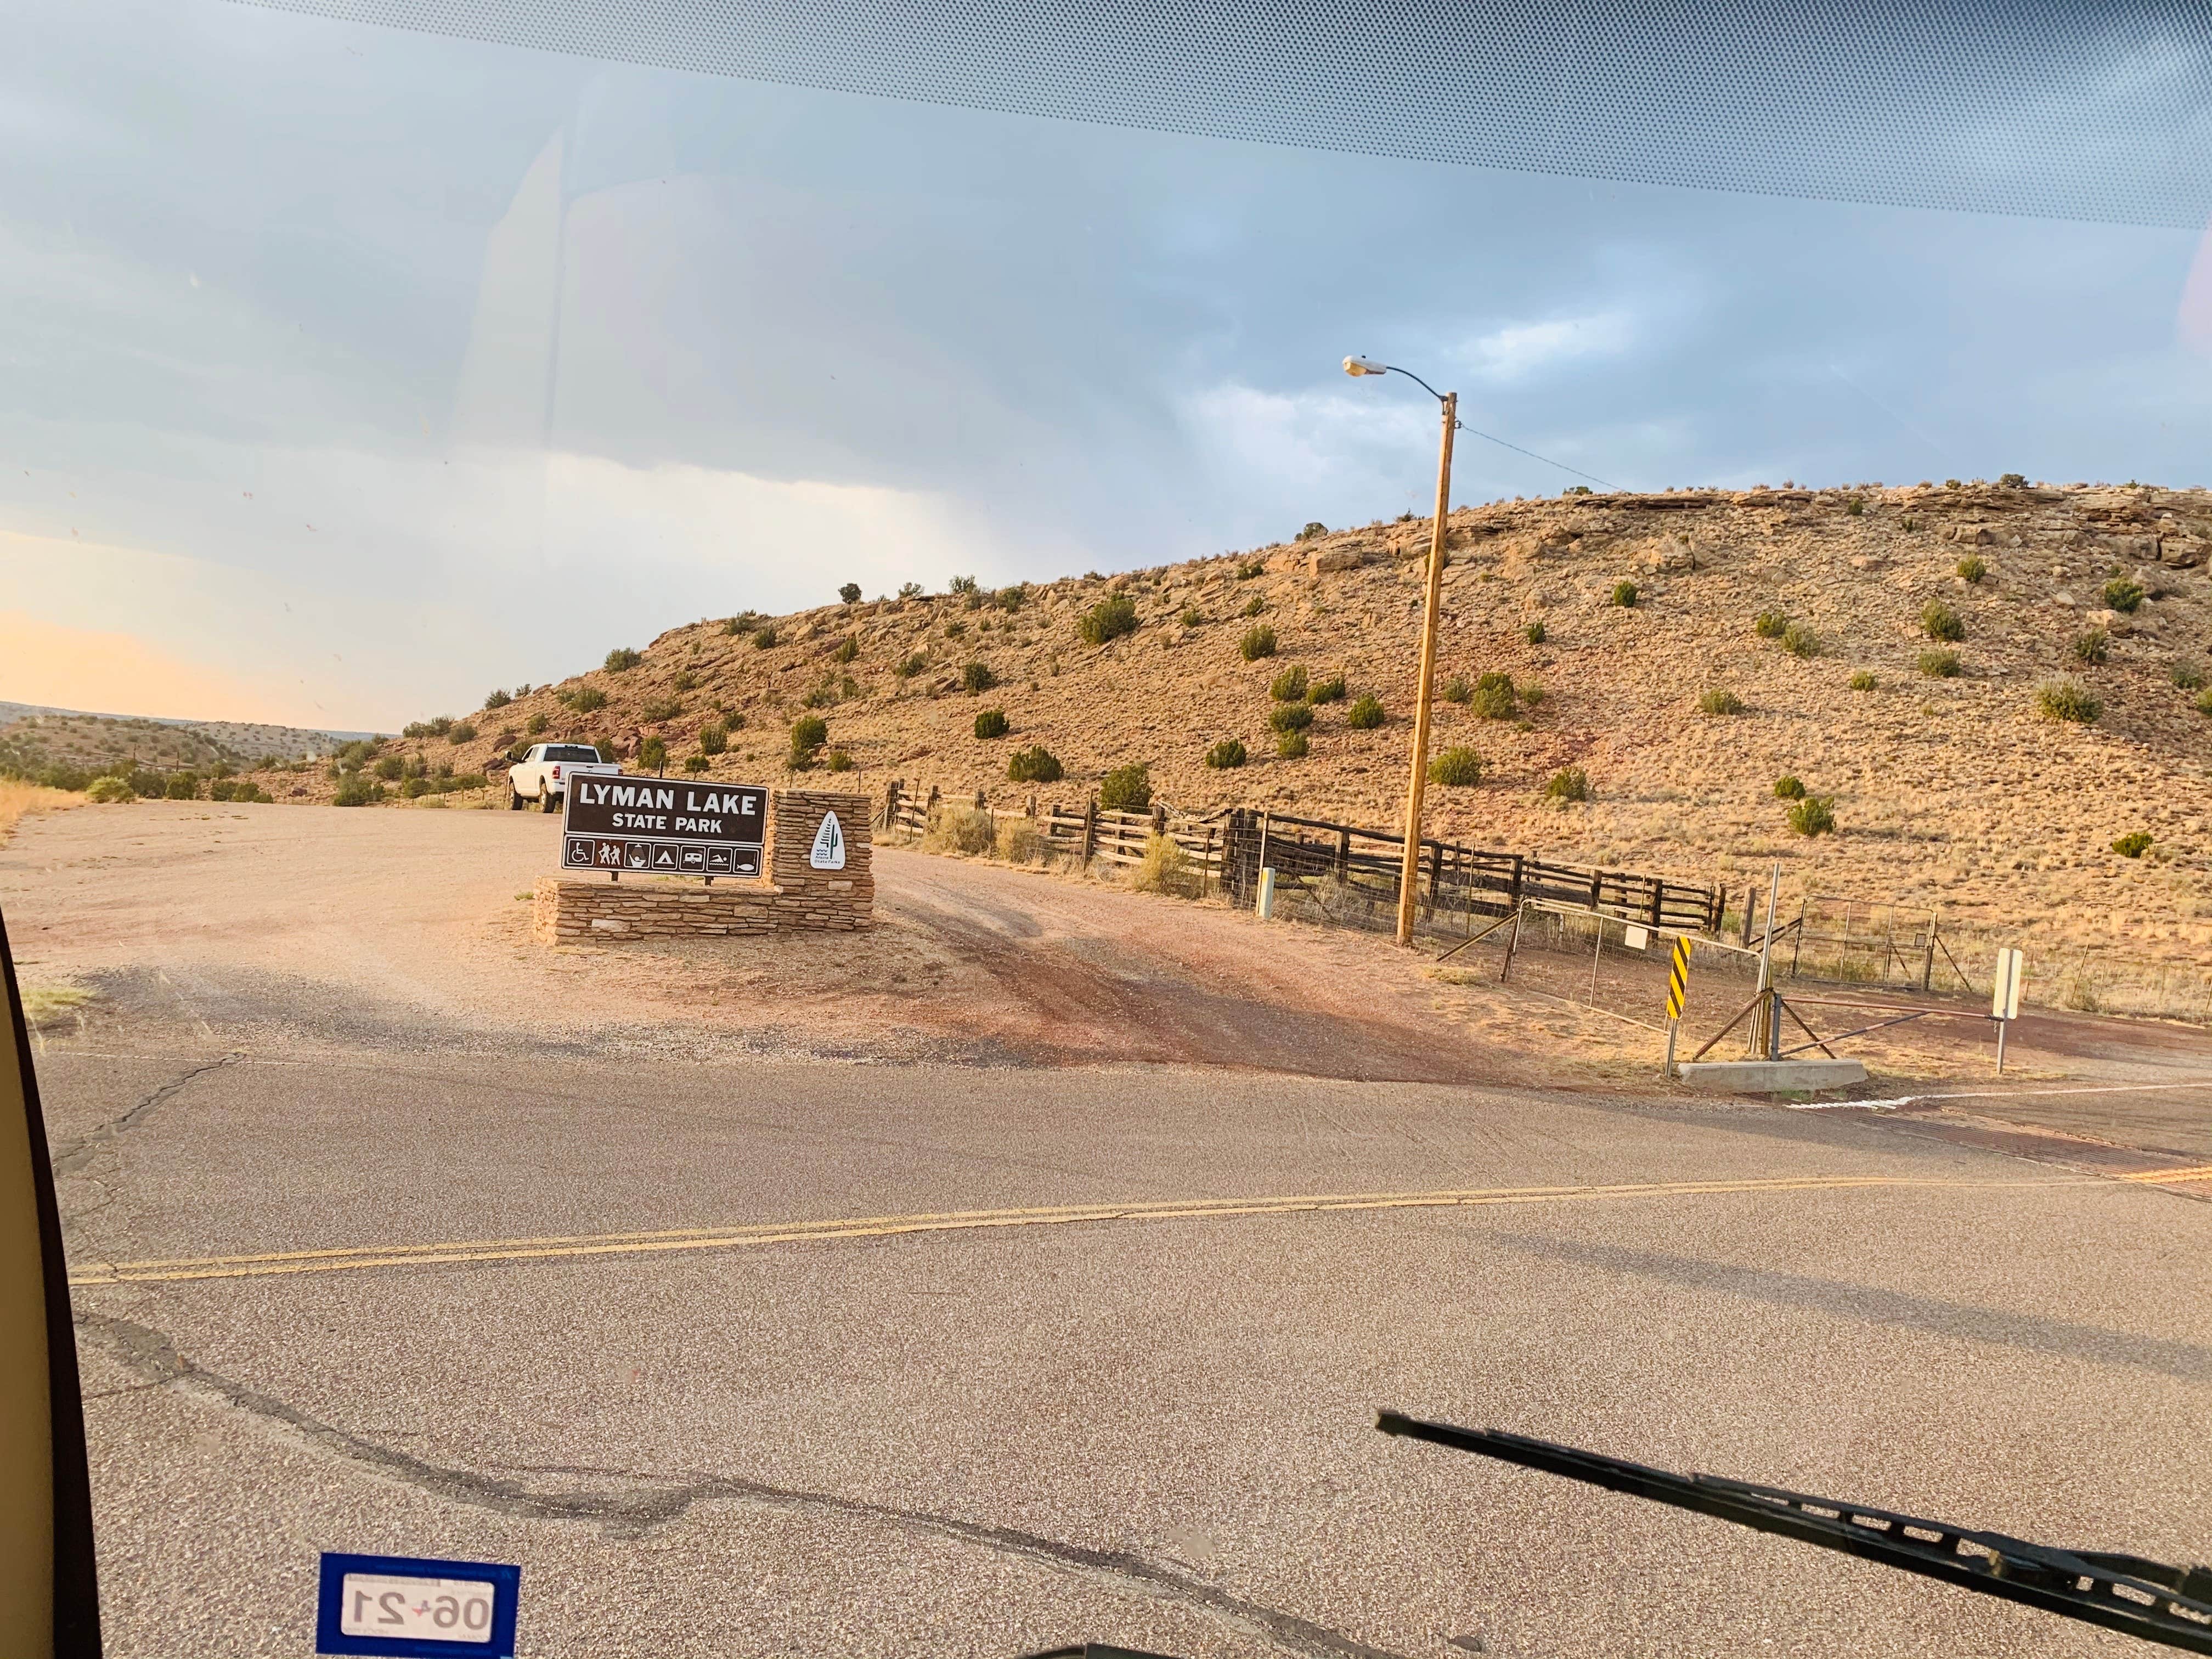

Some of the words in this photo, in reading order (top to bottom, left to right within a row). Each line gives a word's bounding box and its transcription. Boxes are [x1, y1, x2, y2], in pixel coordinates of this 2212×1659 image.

[580, 783, 674, 810] LYMAN
[687, 791, 757, 816] LAKE
[612, 812, 667, 830] STATE
[675, 816, 723, 833] PARK
